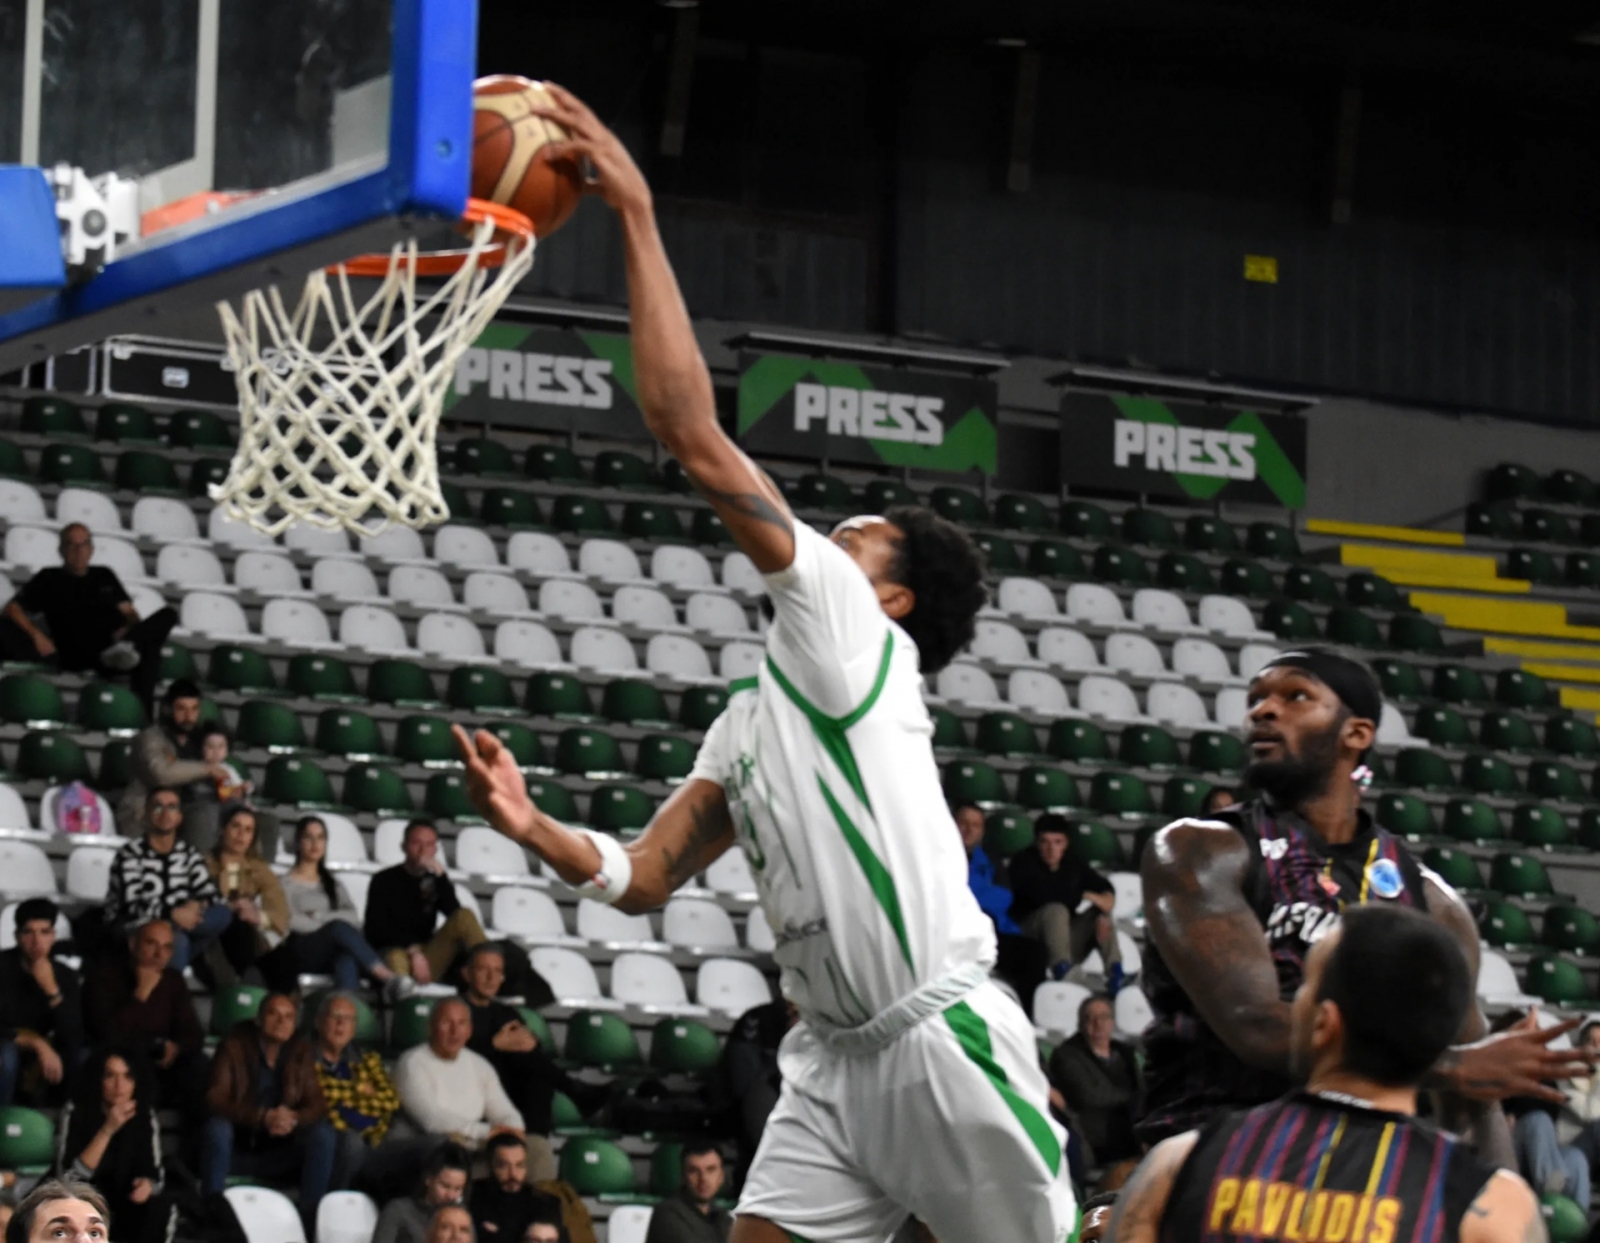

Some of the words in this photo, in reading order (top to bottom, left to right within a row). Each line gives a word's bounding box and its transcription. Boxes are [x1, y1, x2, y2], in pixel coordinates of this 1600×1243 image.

[455, 347, 613, 410] PRESS
[794, 382, 944, 445] PRESS
[1113, 418, 1257, 481] PRESS
[1207, 1176, 1402, 1243] PAVLIDIS
